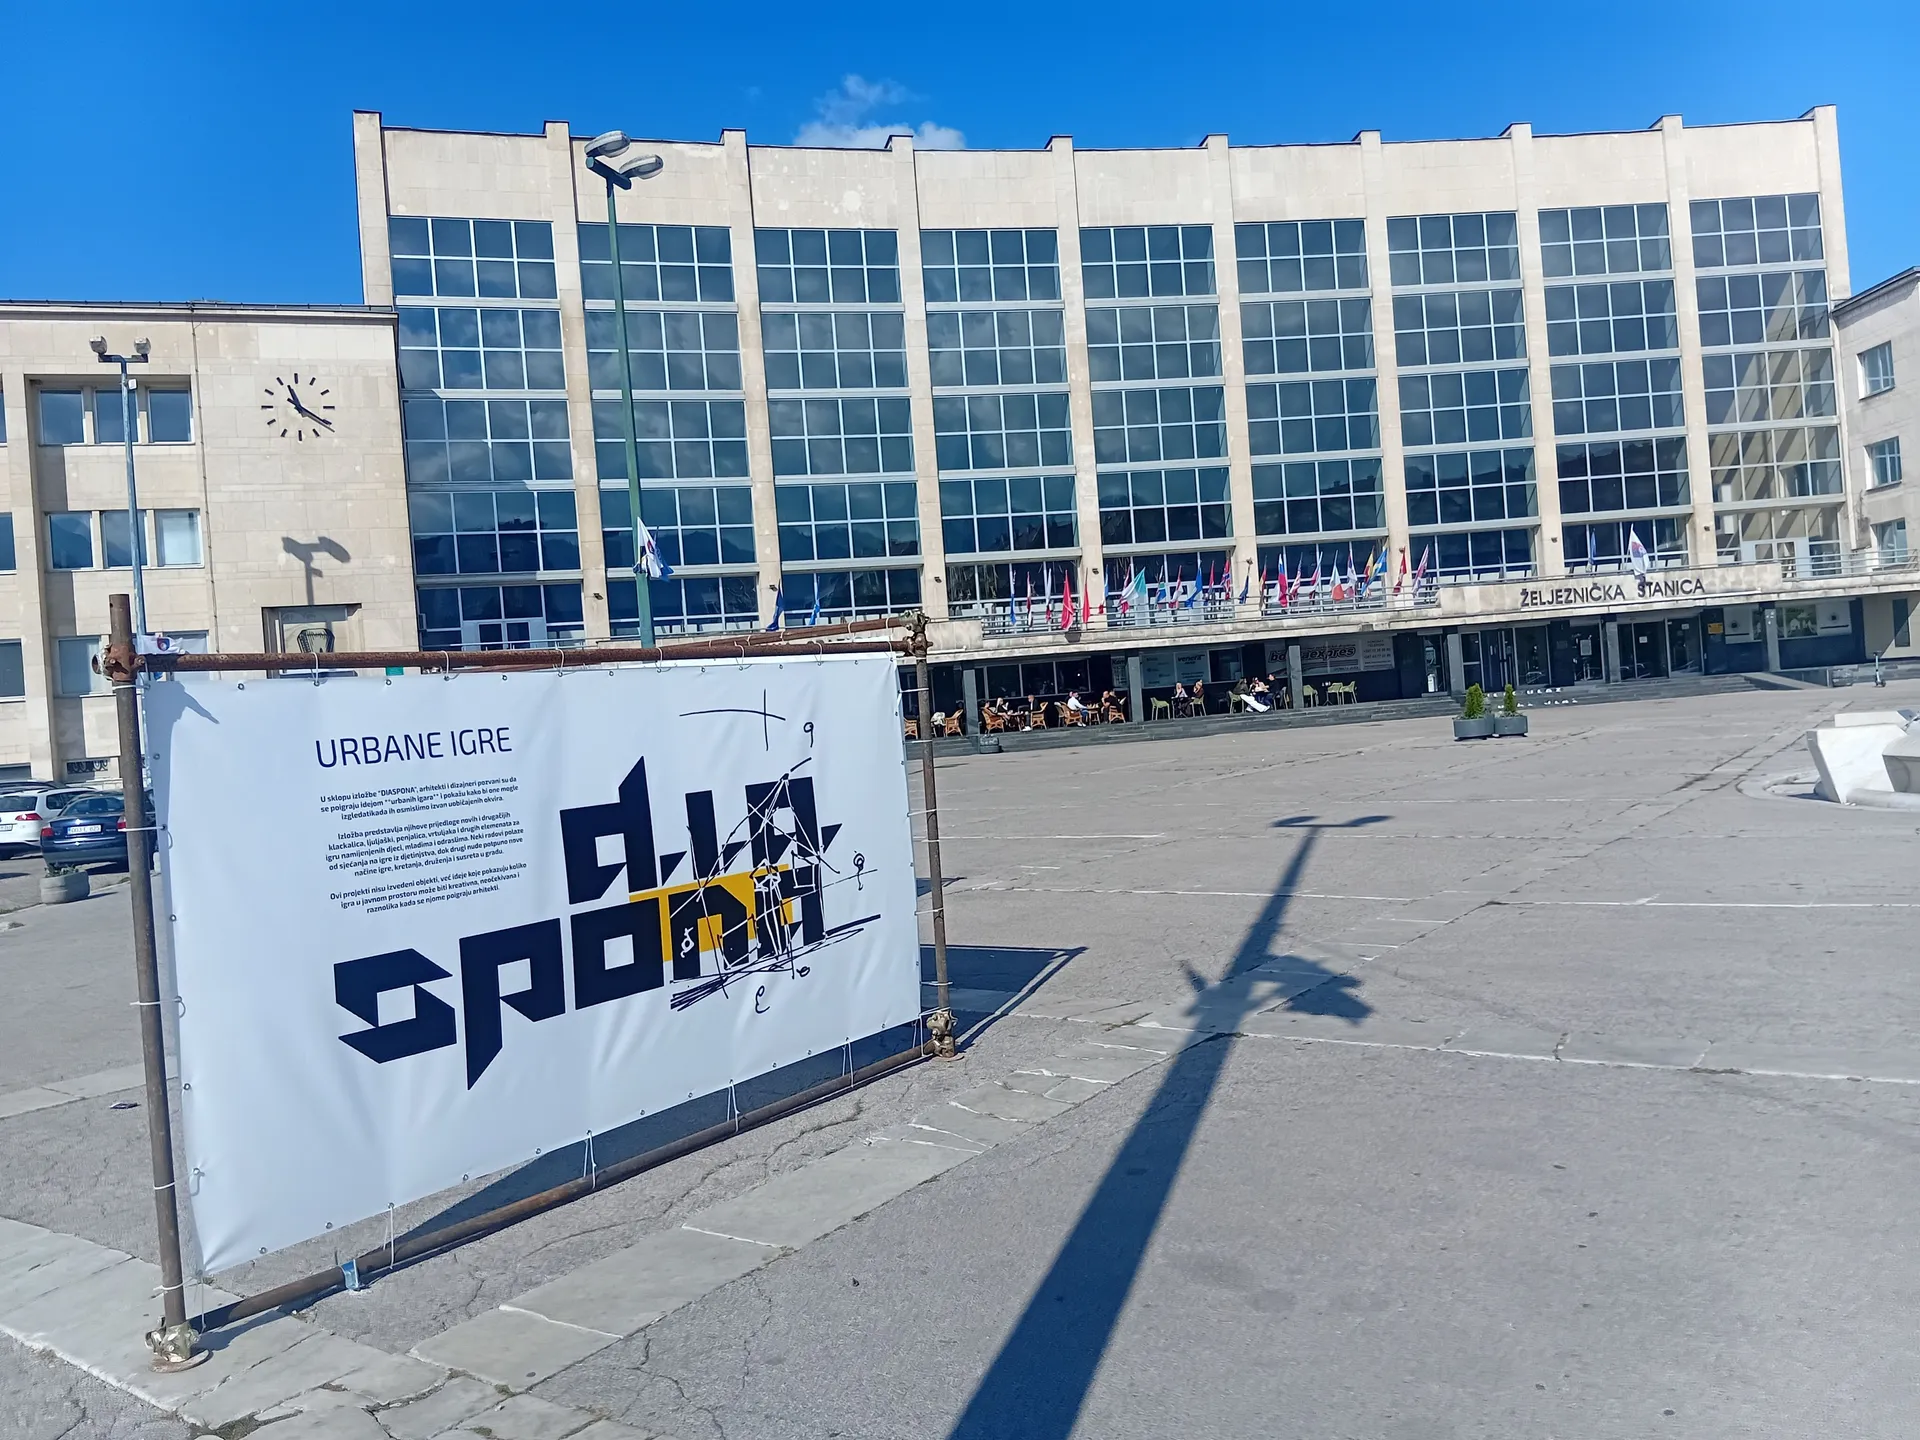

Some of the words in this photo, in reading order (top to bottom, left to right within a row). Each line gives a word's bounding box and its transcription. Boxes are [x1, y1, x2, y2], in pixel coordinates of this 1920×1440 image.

[1520, 582, 1626, 607] ŽELJEZNIČKA
[315, 731, 445, 768] URBANE
[450, 726, 513, 757] IGRE
[352, 791, 377, 800] izložbe
[420, 782, 446, 792] arhitekti
[450, 780, 477, 789] dizajneri
[477, 778, 501, 787] pozvani
[330, 803, 360, 813] poigraju
[360, 800, 384, 809] idejom
[396, 803, 430, 813] osmislimo
[431, 802, 448, 810] izvan
[338, 831, 364, 840] Izložba
[365, 826, 403, 838] predstavlja
[404, 824, 428, 834] njihove
[429, 820, 460, 829] prijedloge
[461, 816, 478, 824] novih
[428, 828, 457, 838] vrtuljaka
[460, 825, 480, 833] drugih
[325, 854, 340, 862] igru
[405, 841, 433, 850] mladima
[485, 829, 504, 838] radovi
[505, 827, 524, 836] polaze
[329, 863, 338, 871] od
[379, 856, 393, 864] igre
[437, 847, 449, 855] dok
[450, 844, 466, 853] drugi
[467, 842, 482, 850] nude
[456, 852, 479, 860] susreta
[330, 892, 342, 900] Ovi
[343, 887, 370, 899] projekti
[371, 886, 386, 894] nisu
[387, 880, 415, 890] izvedeni
[452, 872, 467, 880] ideje
[482, 866, 509, 876] pokazuju
[509, 862, 527, 870] koliko
[341, 900, 355, 909] igra
[362, 896, 388, 906] javnom
[389, 890, 417, 902] prostoru
[437, 884, 448, 892] biti
[367, 903, 399, 914] raznolika
[400, 899, 416, 907] kada
[426, 894, 445, 903] njome
